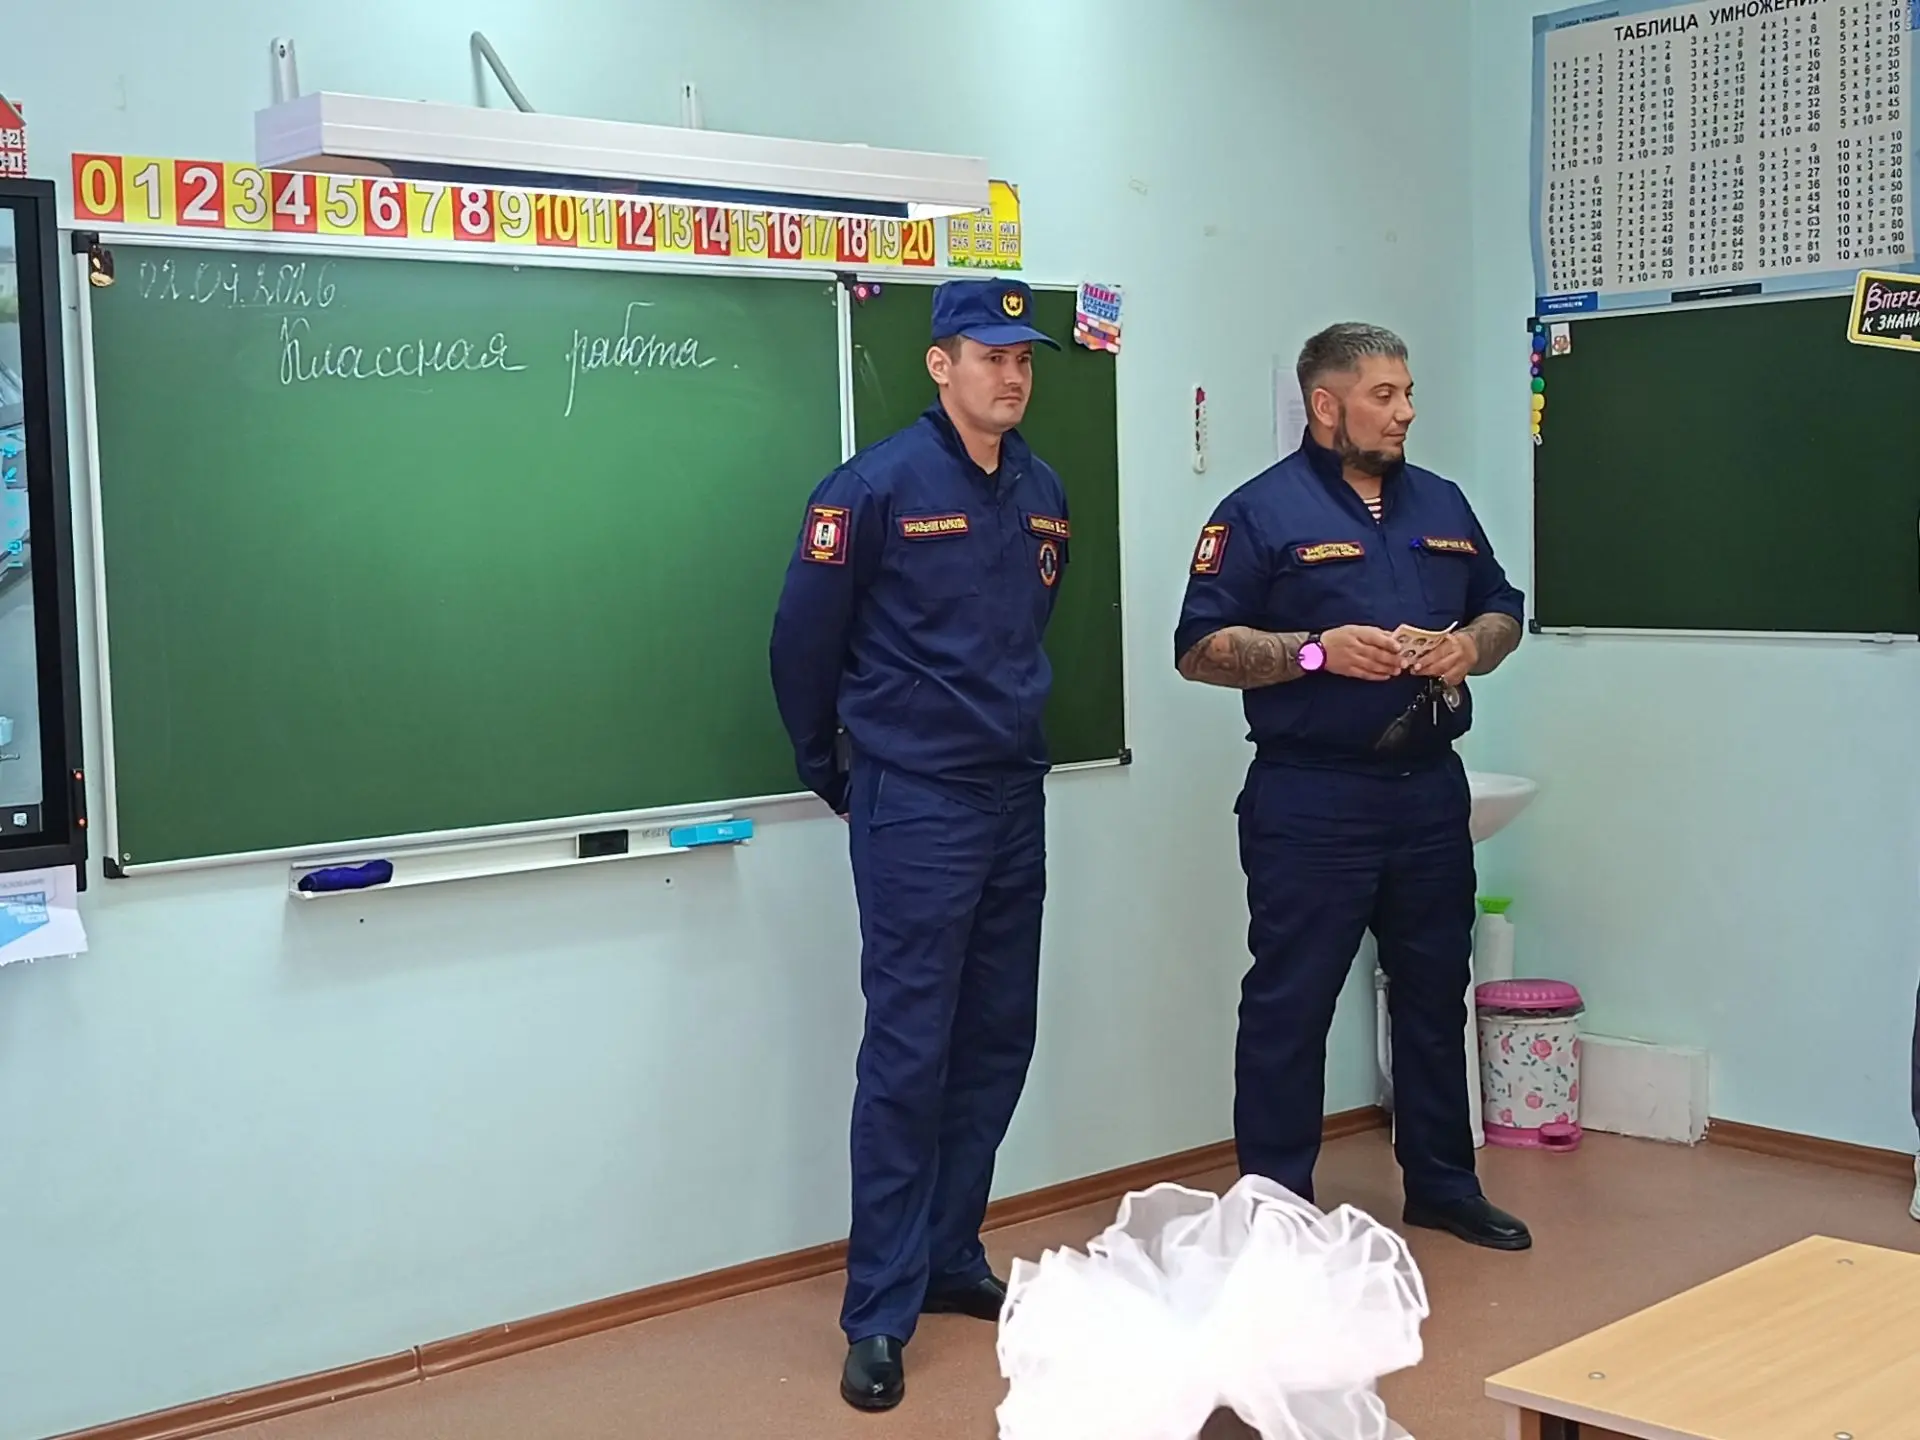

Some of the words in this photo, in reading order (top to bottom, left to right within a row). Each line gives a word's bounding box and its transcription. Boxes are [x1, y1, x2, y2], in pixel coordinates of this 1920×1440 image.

[1614, 14, 1699, 41] ТАБЛИЦА
[1840, 19, 1846, 29] 5
[1864, 14, 1870, 24] 2
[1889, 8, 1900, 19] 10
[1840, 31, 1846, 41] 5
[1864, 27, 1870, 37] 3
[1889, 21, 1900, 32] 15
[1760, 45, 1766, 54] 4
[1782, 41, 1788, 51] 3
[1808, 35, 1820, 46] 12
[1840, 44, 1846, 54] 5
[1864, 40, 1870, 48] 4
[1888, 33, 1900, 45] 20
[1760, 58, 1765, 66] 4
[1782, 54, 1788, 63] 4
[1809, 48, 1821, 58] 16
[1840, 56, 1846, 66] 5
[1865, 52, 1870, 62] 5
[1888, 46, 1900, 58] 25
[1618, 72, 1624, 81] 2
[1640, 68, 1646, 78] 3
[1665, 64, 1671, 73] 6
[1760, 70, 1765, 78] 4
[1782, 65, 1789, 75] 5
[1807, 60, 1820, 71] 20
[1840, 68, 1846, 79] 5
[1864, 64, 1871, 74] 6
[1888, 58, 1900, 70] 30
[1618, 95, 1624, 104] 2
[1640, 91, 1646, 101] 5
[1663, 87, 1674, 97] 10
[1618, 106, 1624, 116] 2
[1640, 102, 1645, 112] 6
[1663, 98, 1674, 109] 12
[1840, 118, 1846, 128] 5
[1862, 114, 1874, 125] 10
[1888, 110, 1900, 120] 50
[1760, 131, 1765, 139] 4
[1780, 126, 1792, 136] 10
[1807, 122, 1820, 132] 40
[1837, 139, 1850, 148] 10
[1868, 136, 1872, 144] 1
[1891, 130, 1902, 140] 10
[1618, 152, 1623, 162] 2
[1638, 149, 1648, 159] 10
[1662, 146, 1674, 156] 20
[1759, 175, 1765, 184] 9
[1782, 171, 1788, 181] 3
[1808, 167, 1820, 178] 27
[1837, 176, 1850, 186] 10
[1868, 172, 1873, 182] 4
[1890, 168, 1902, 178] 40
[80, 160, 117, 215] 0
[134, 163, 160, 219] 1
[182, 167, 219, 221] 2
[233, 169, 267, 223] 3
[276, 174, 310, 225] 4
[325, 177, 358, 227] 5
[370, 180, 400, 230] 6
[413, 183, 446, 232] 7
[460, 187, 490, 234] 8
[500, 191, 531, 238] 9
[536, 195, 575, 240] 10
[580, 198, 611, 243] 11
[618, 200, 653, 245] 12
[658, 203, 692, 248] 13
[695, 207, 729, 251] 14
[732, 209, 765, 253] 15
[768, 212, 801, 254] 16
[805, 215, 834, 256] 17
[838, 218, 867, 257] 18
[871, 220, 900, 259] 19
[903, 221, 933, 260] 20
[1837, 200, 1850, 210] 10
[1868, 198, 1874, 208] 6
[1890, 194, 1903, 204] 60
[1617, 218, 1622, 226] 7
[1640, 215, 1644, 224] 5
[1662, 212, 1674, 221] 35
[1838, 213, 1850, 224] 10
[1868, 210, 1874, 220] 7
[1891, 206, 1903, 217] 70
[1759, 259, 1765, 268] 9
[1781, 256, 1792, 266] 10
[1807, 252, 1820, 263] 90
[1837, 250, 1850, 260] 10
[1864, 248, 1874, 257] 10
[1887, 244, 1905, 254] 100
[280, 316, 528, 385] Классная
